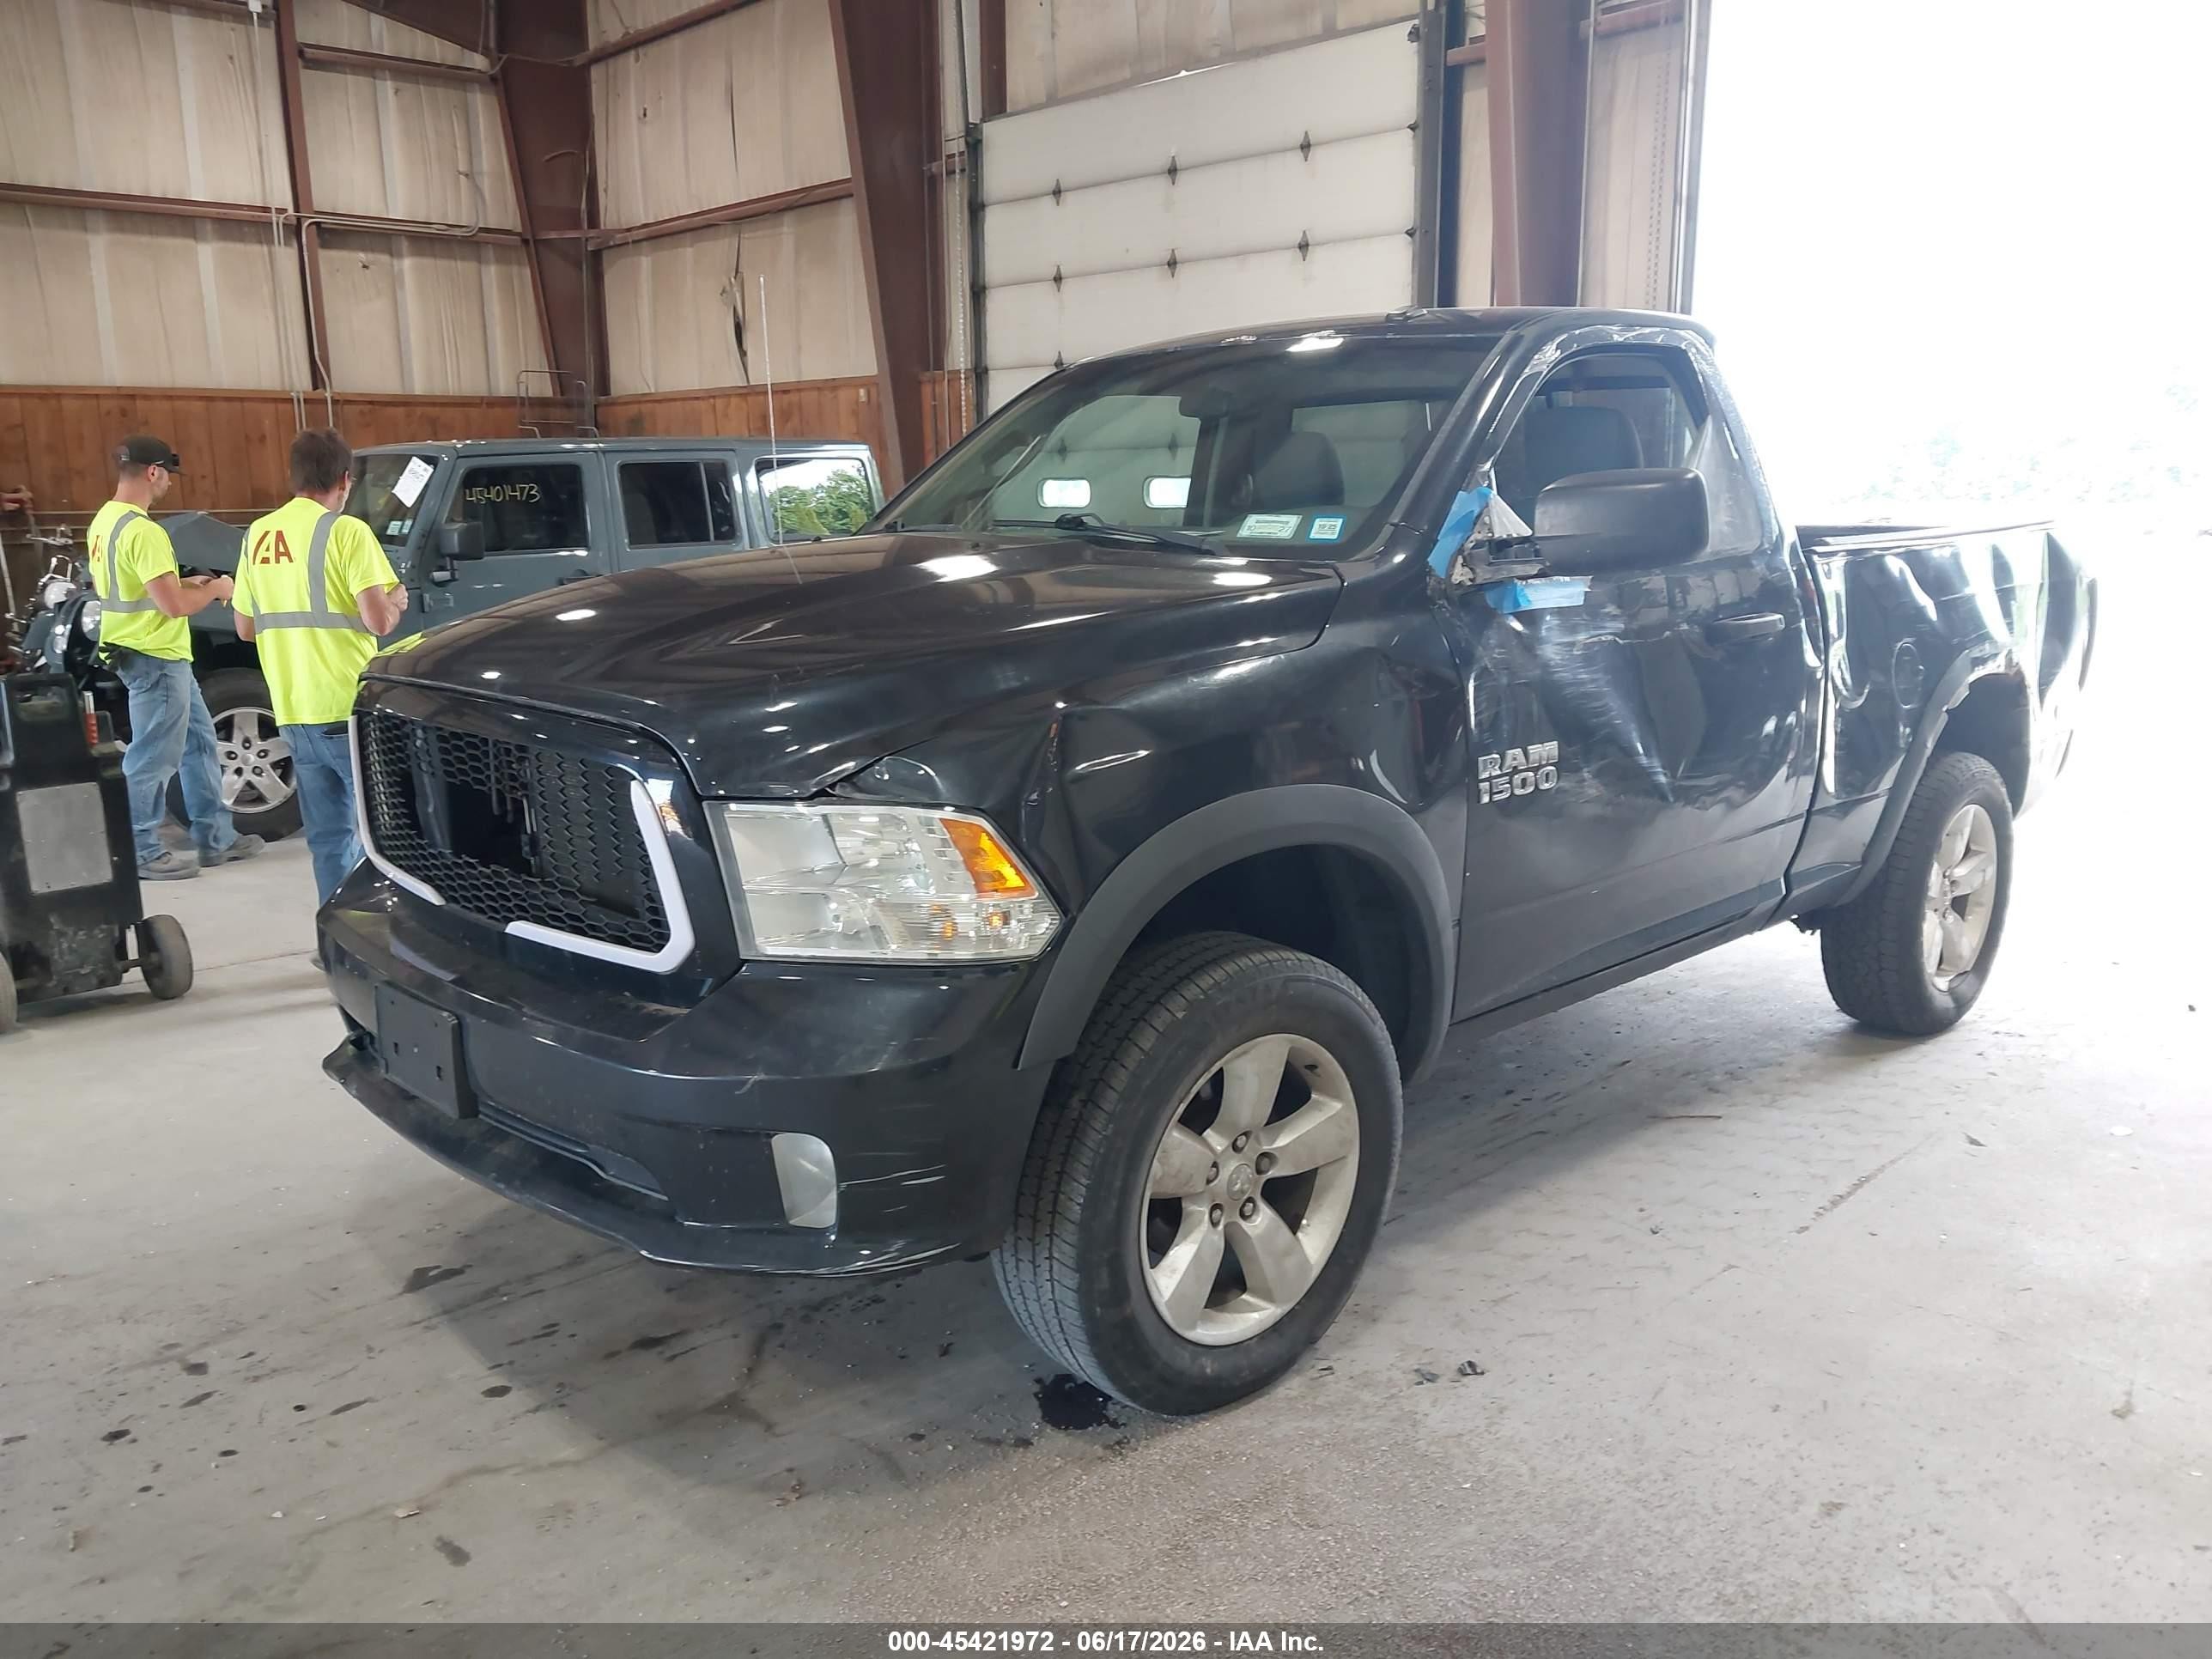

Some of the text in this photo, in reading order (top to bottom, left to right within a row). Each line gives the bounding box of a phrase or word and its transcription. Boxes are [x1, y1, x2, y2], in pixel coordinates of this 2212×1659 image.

[465, 483, 542, 505] 45401473
[1478, 740, 1559, 780] RAM
[1478, 765, 1559, 805] 1500
